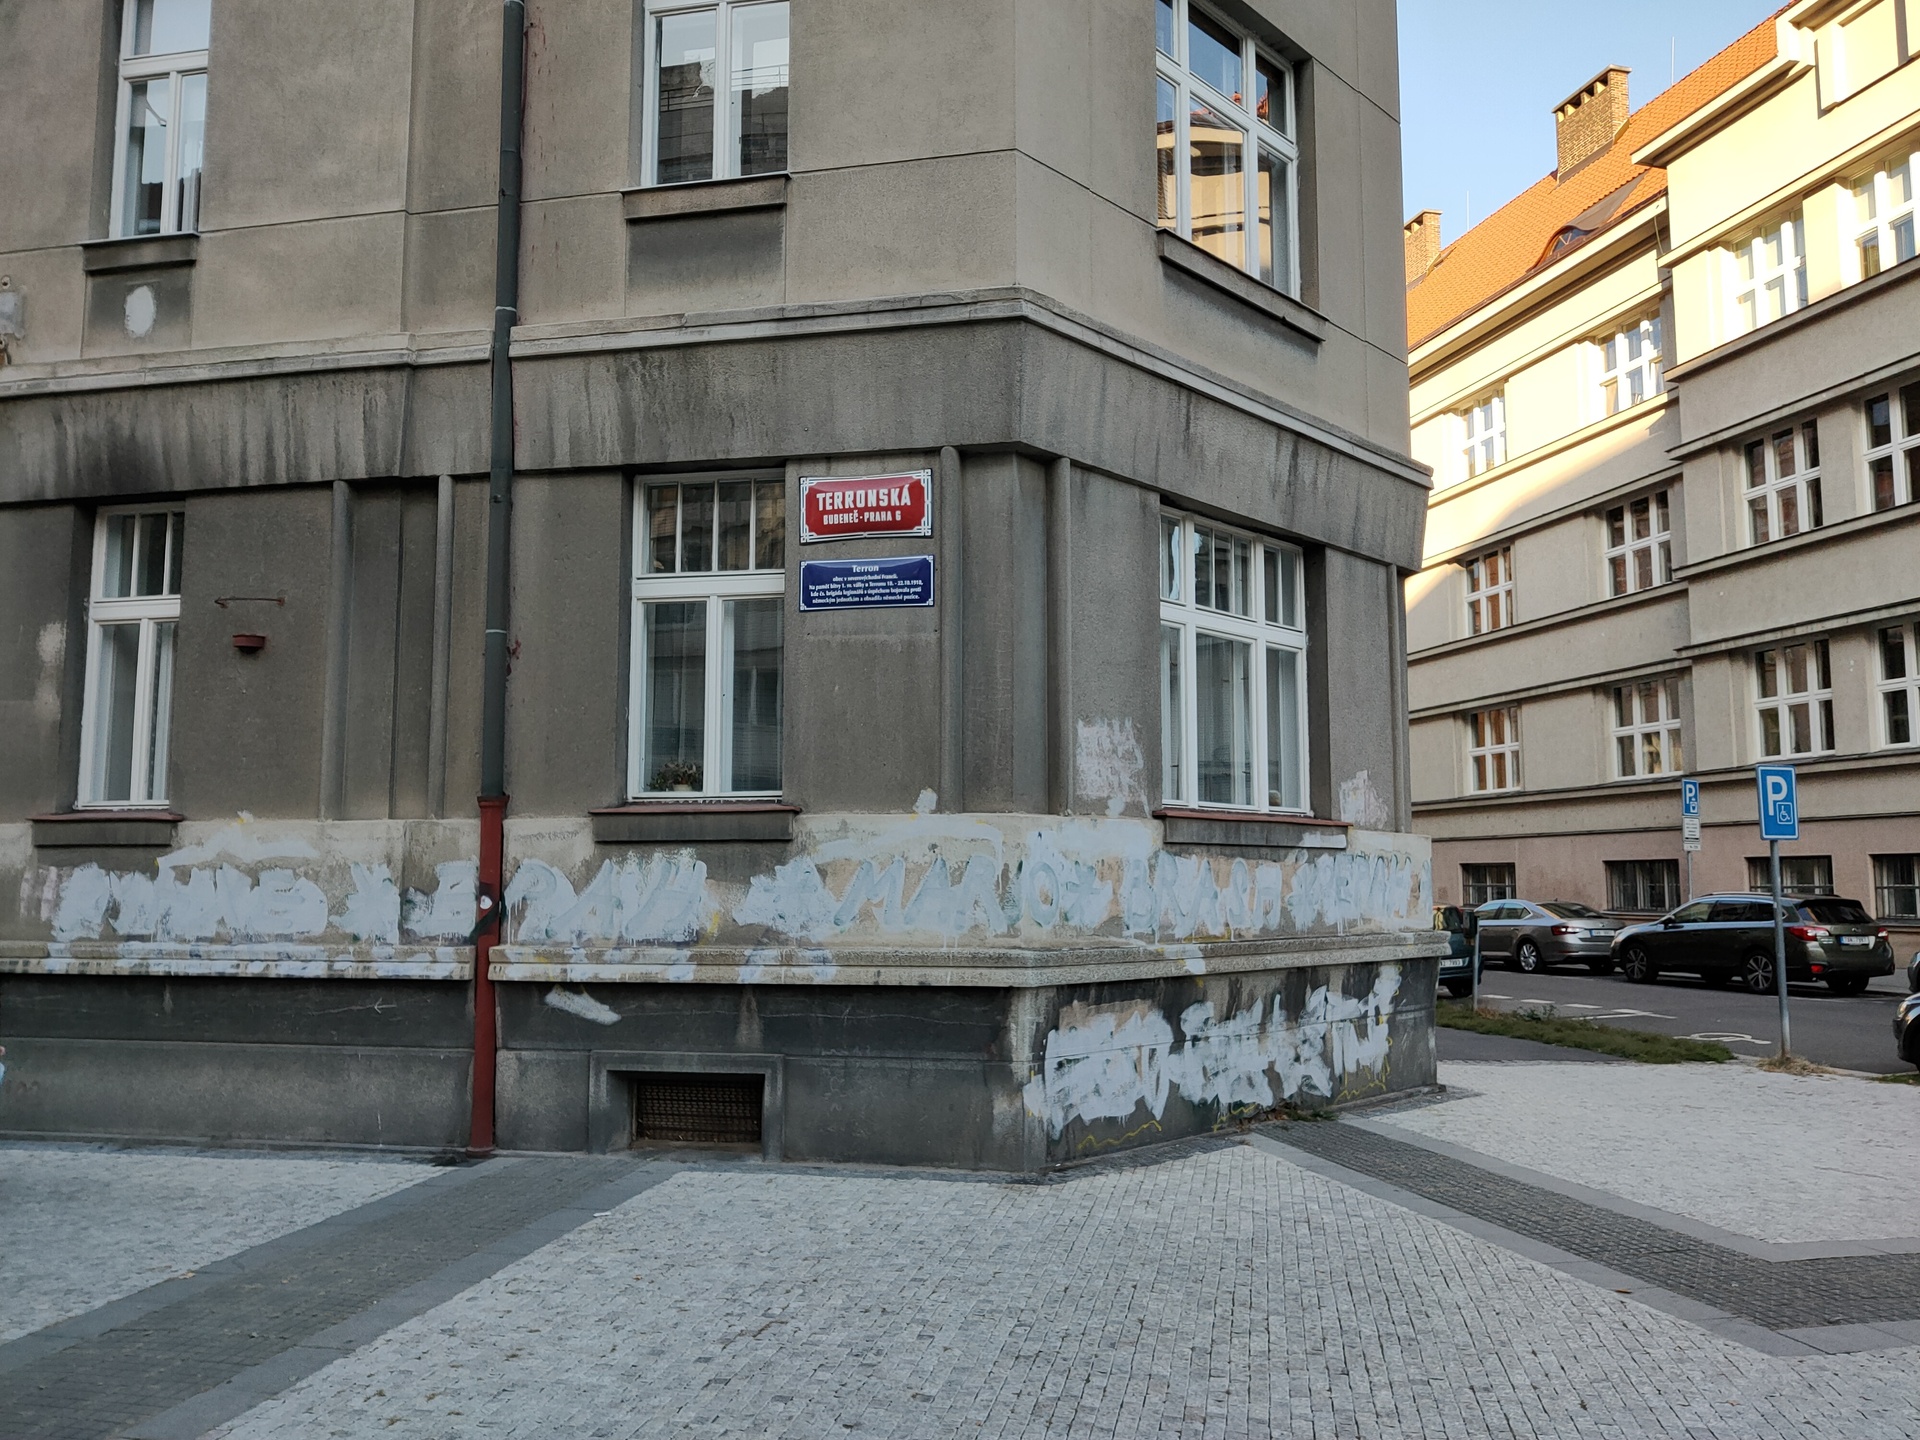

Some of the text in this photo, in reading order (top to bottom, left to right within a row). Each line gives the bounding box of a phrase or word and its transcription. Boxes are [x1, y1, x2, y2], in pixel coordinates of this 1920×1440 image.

[816, 484, 911, 511] TERRONSKÁ
[864, 510, 892, 522] PRAHA
[895, 510, 901, 521] 6
[852, 565, 879, 573] Terron
[1686, 784, 1695, 804] P
[1766, 775, 1788, 816] P
